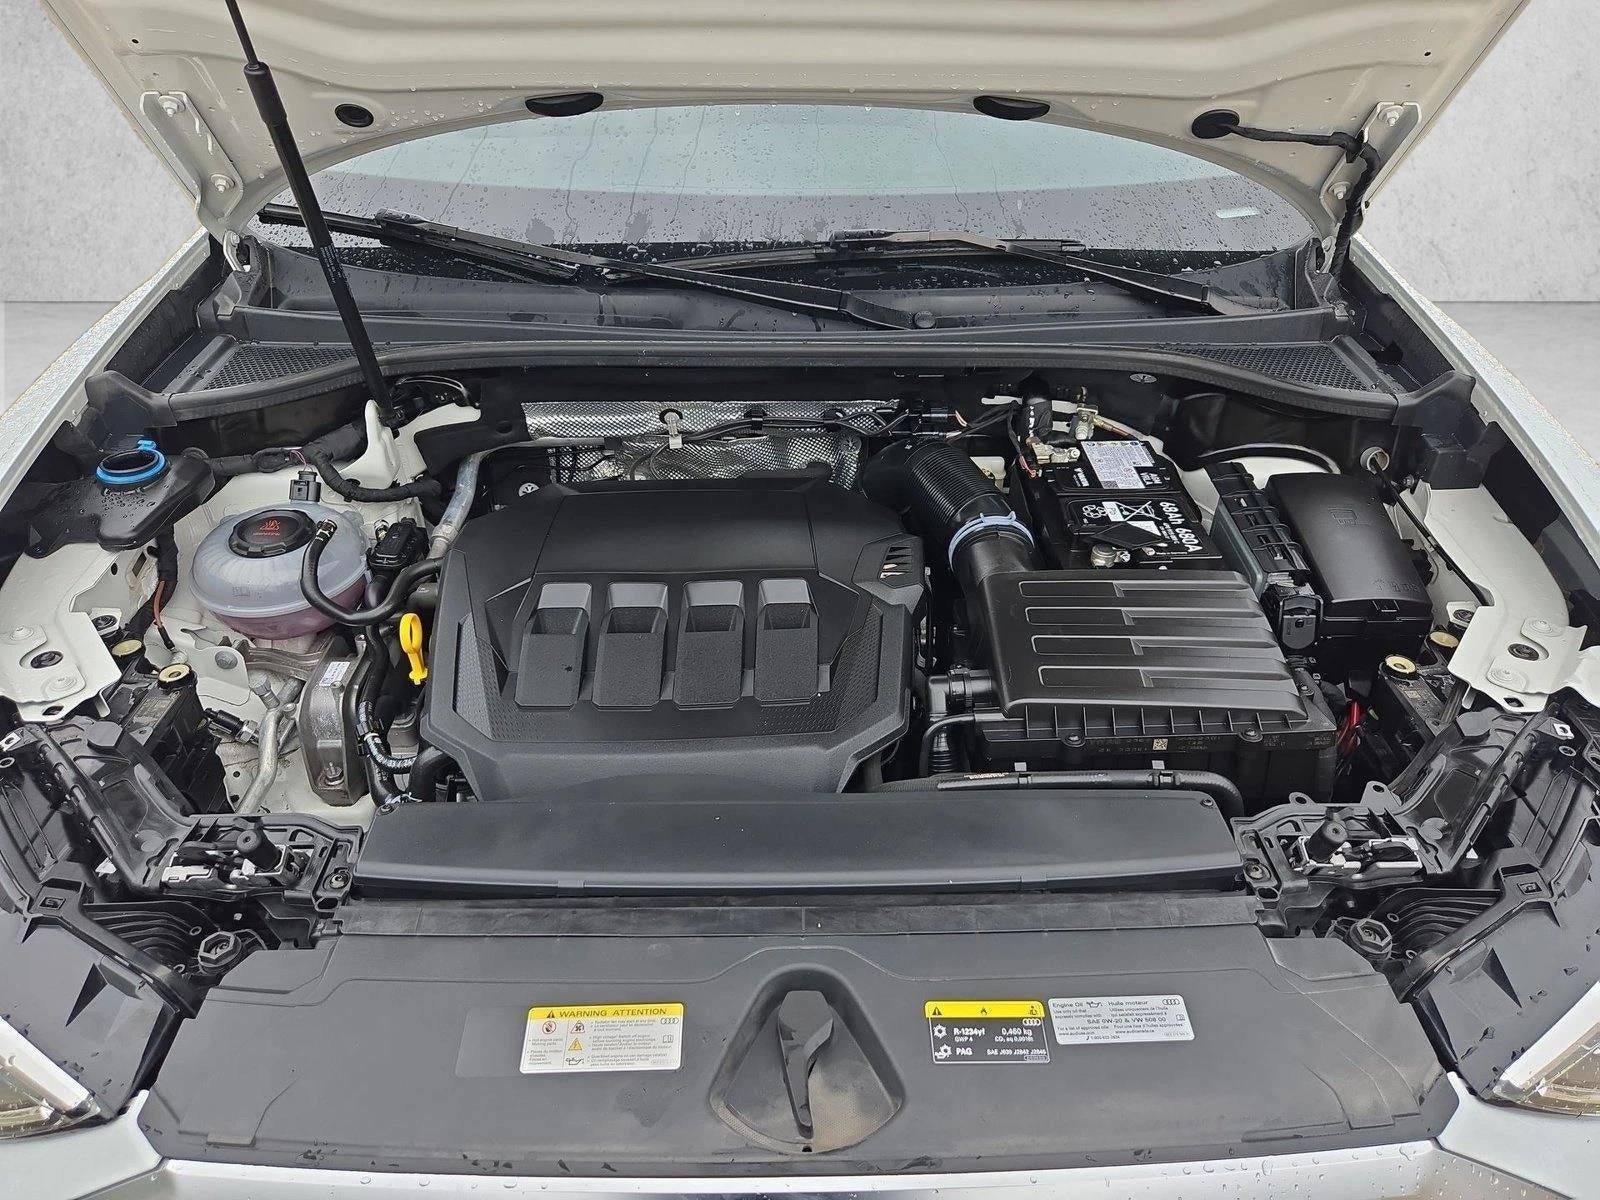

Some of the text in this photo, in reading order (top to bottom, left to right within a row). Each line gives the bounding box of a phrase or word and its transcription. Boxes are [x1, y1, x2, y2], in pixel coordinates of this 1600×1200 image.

[1160, 502, 1185, 524] 68Ah
[1175, 528, 1203, 552] 680A
[560, 1008, 668, 1018] WARNING ATTENTION
[1023, 1028, 1033, 1036] kg
[956, 1048, 972, 1056] PAG
